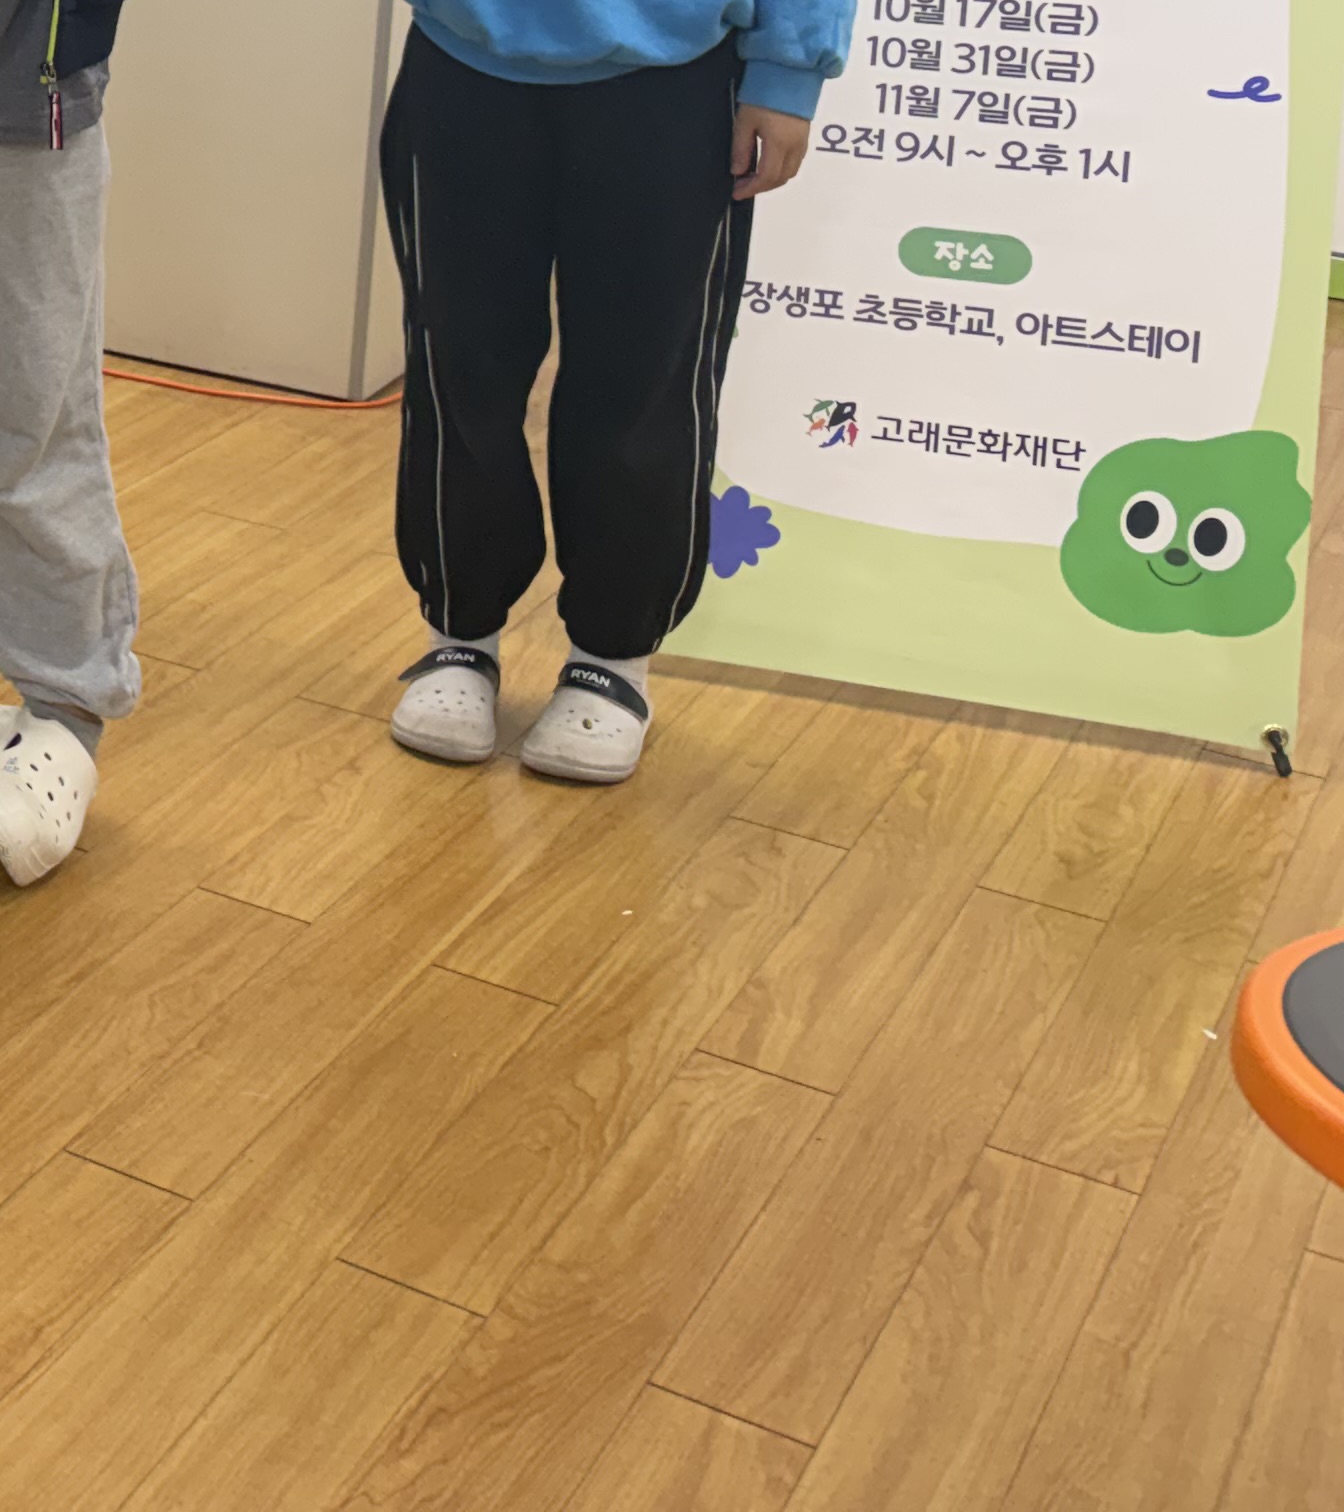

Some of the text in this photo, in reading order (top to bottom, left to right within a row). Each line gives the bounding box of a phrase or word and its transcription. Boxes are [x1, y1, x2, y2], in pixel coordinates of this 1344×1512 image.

[866, 35, 1095, 83] 10월 31일(금)
[874, 83, 1077, 130] 11월 7일(금)
[815, 123, 886, 160] 오전
[894, 131, 956, 167] 9시
[994, 140, 1068, 176] 오후
[1078, 148, 1132, 183] 1시
[933, 240, 995, 271] 장소
[742, 280, 1202, 363] 장생포 초등학교, 아트스테이
[870, 415, 1087, 472] 고래문화재단
[435, 653, 476, 663] RYAN
[570, 668, 611, 688] RYAN
